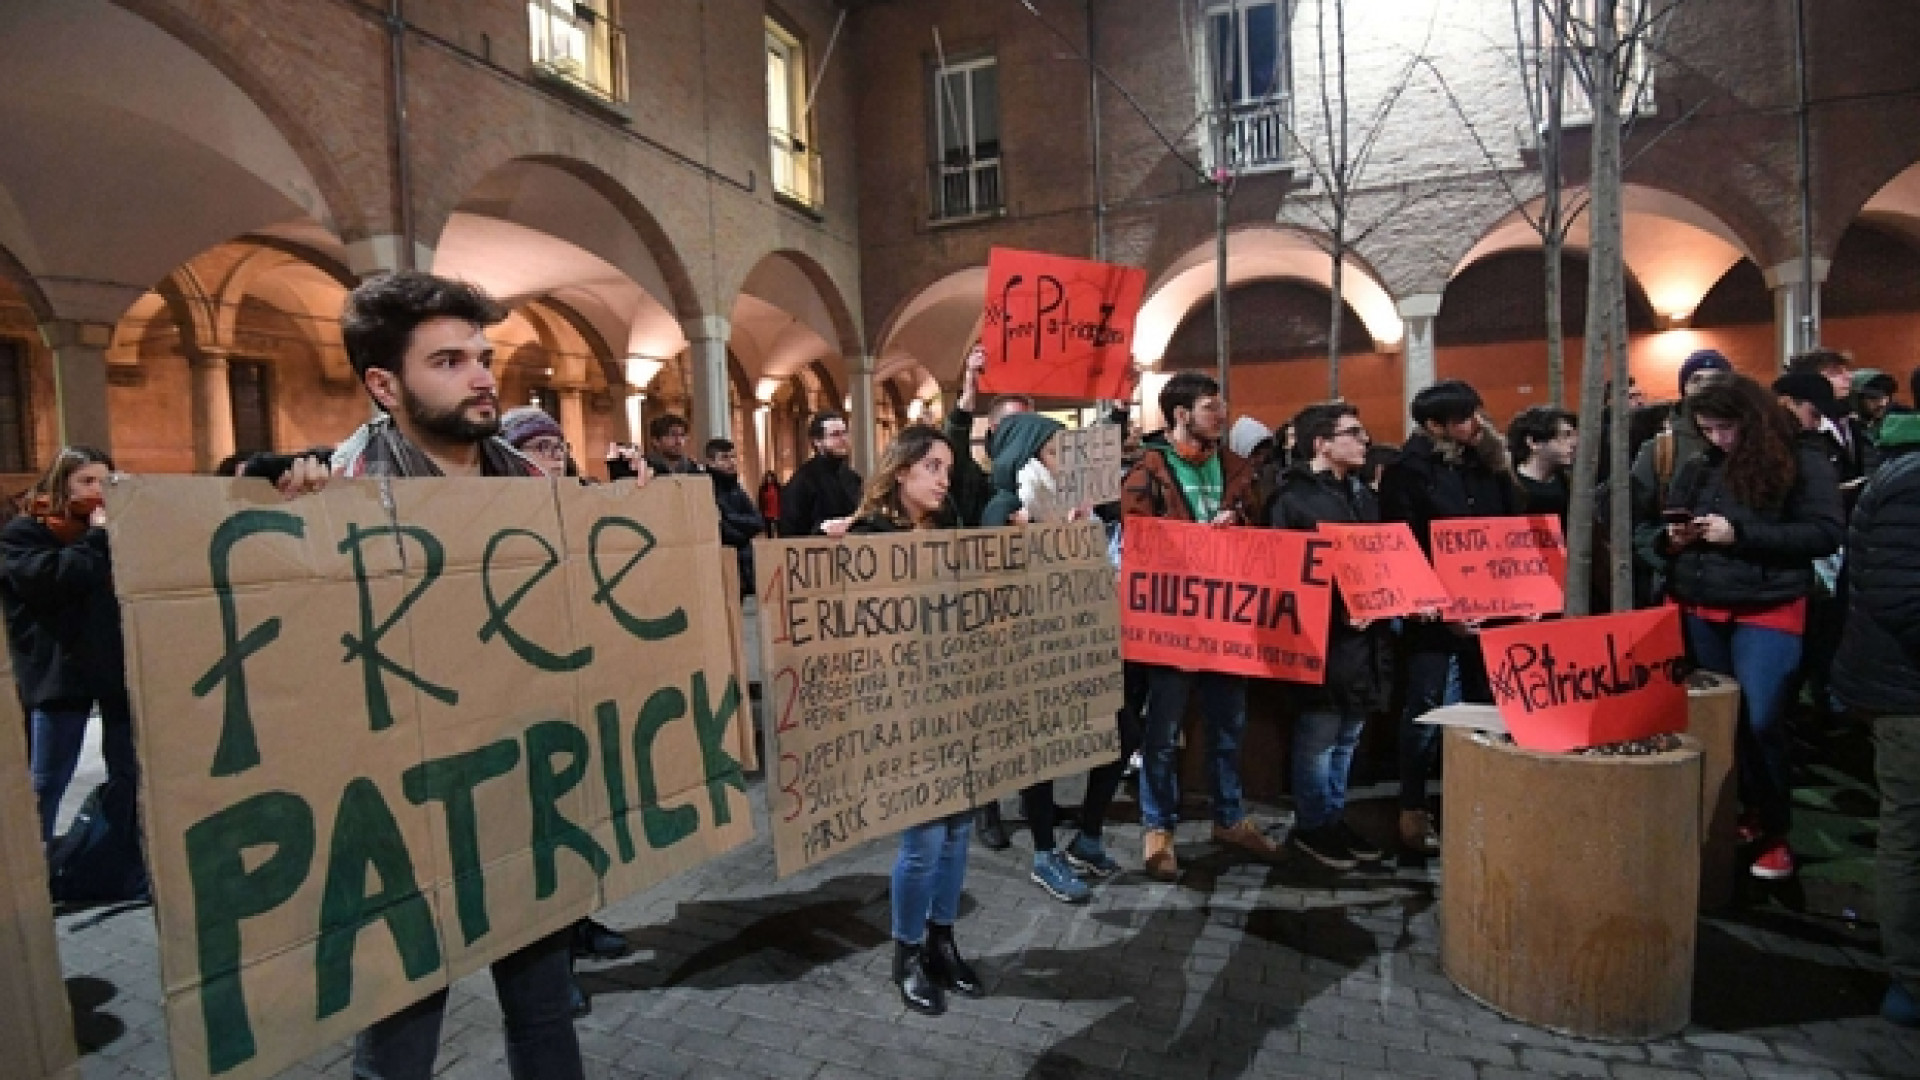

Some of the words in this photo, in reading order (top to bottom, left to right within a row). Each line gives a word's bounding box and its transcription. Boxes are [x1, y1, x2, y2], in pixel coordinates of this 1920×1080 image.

[786, 543, 878, 594] RITIRO
[891, 542, 918, 582] DI
[1301, 538, 1333, 586] E
[789, 596, 813, 647] E
[817, 594, 917, 641] RILASCIO
[1129, 571, 1301, 635] GIUSTIZIA
[774, 665, 800, 735] 2
[780, 753, 803, 824] 3
[184, 670, 747, 1075] PATRICK
